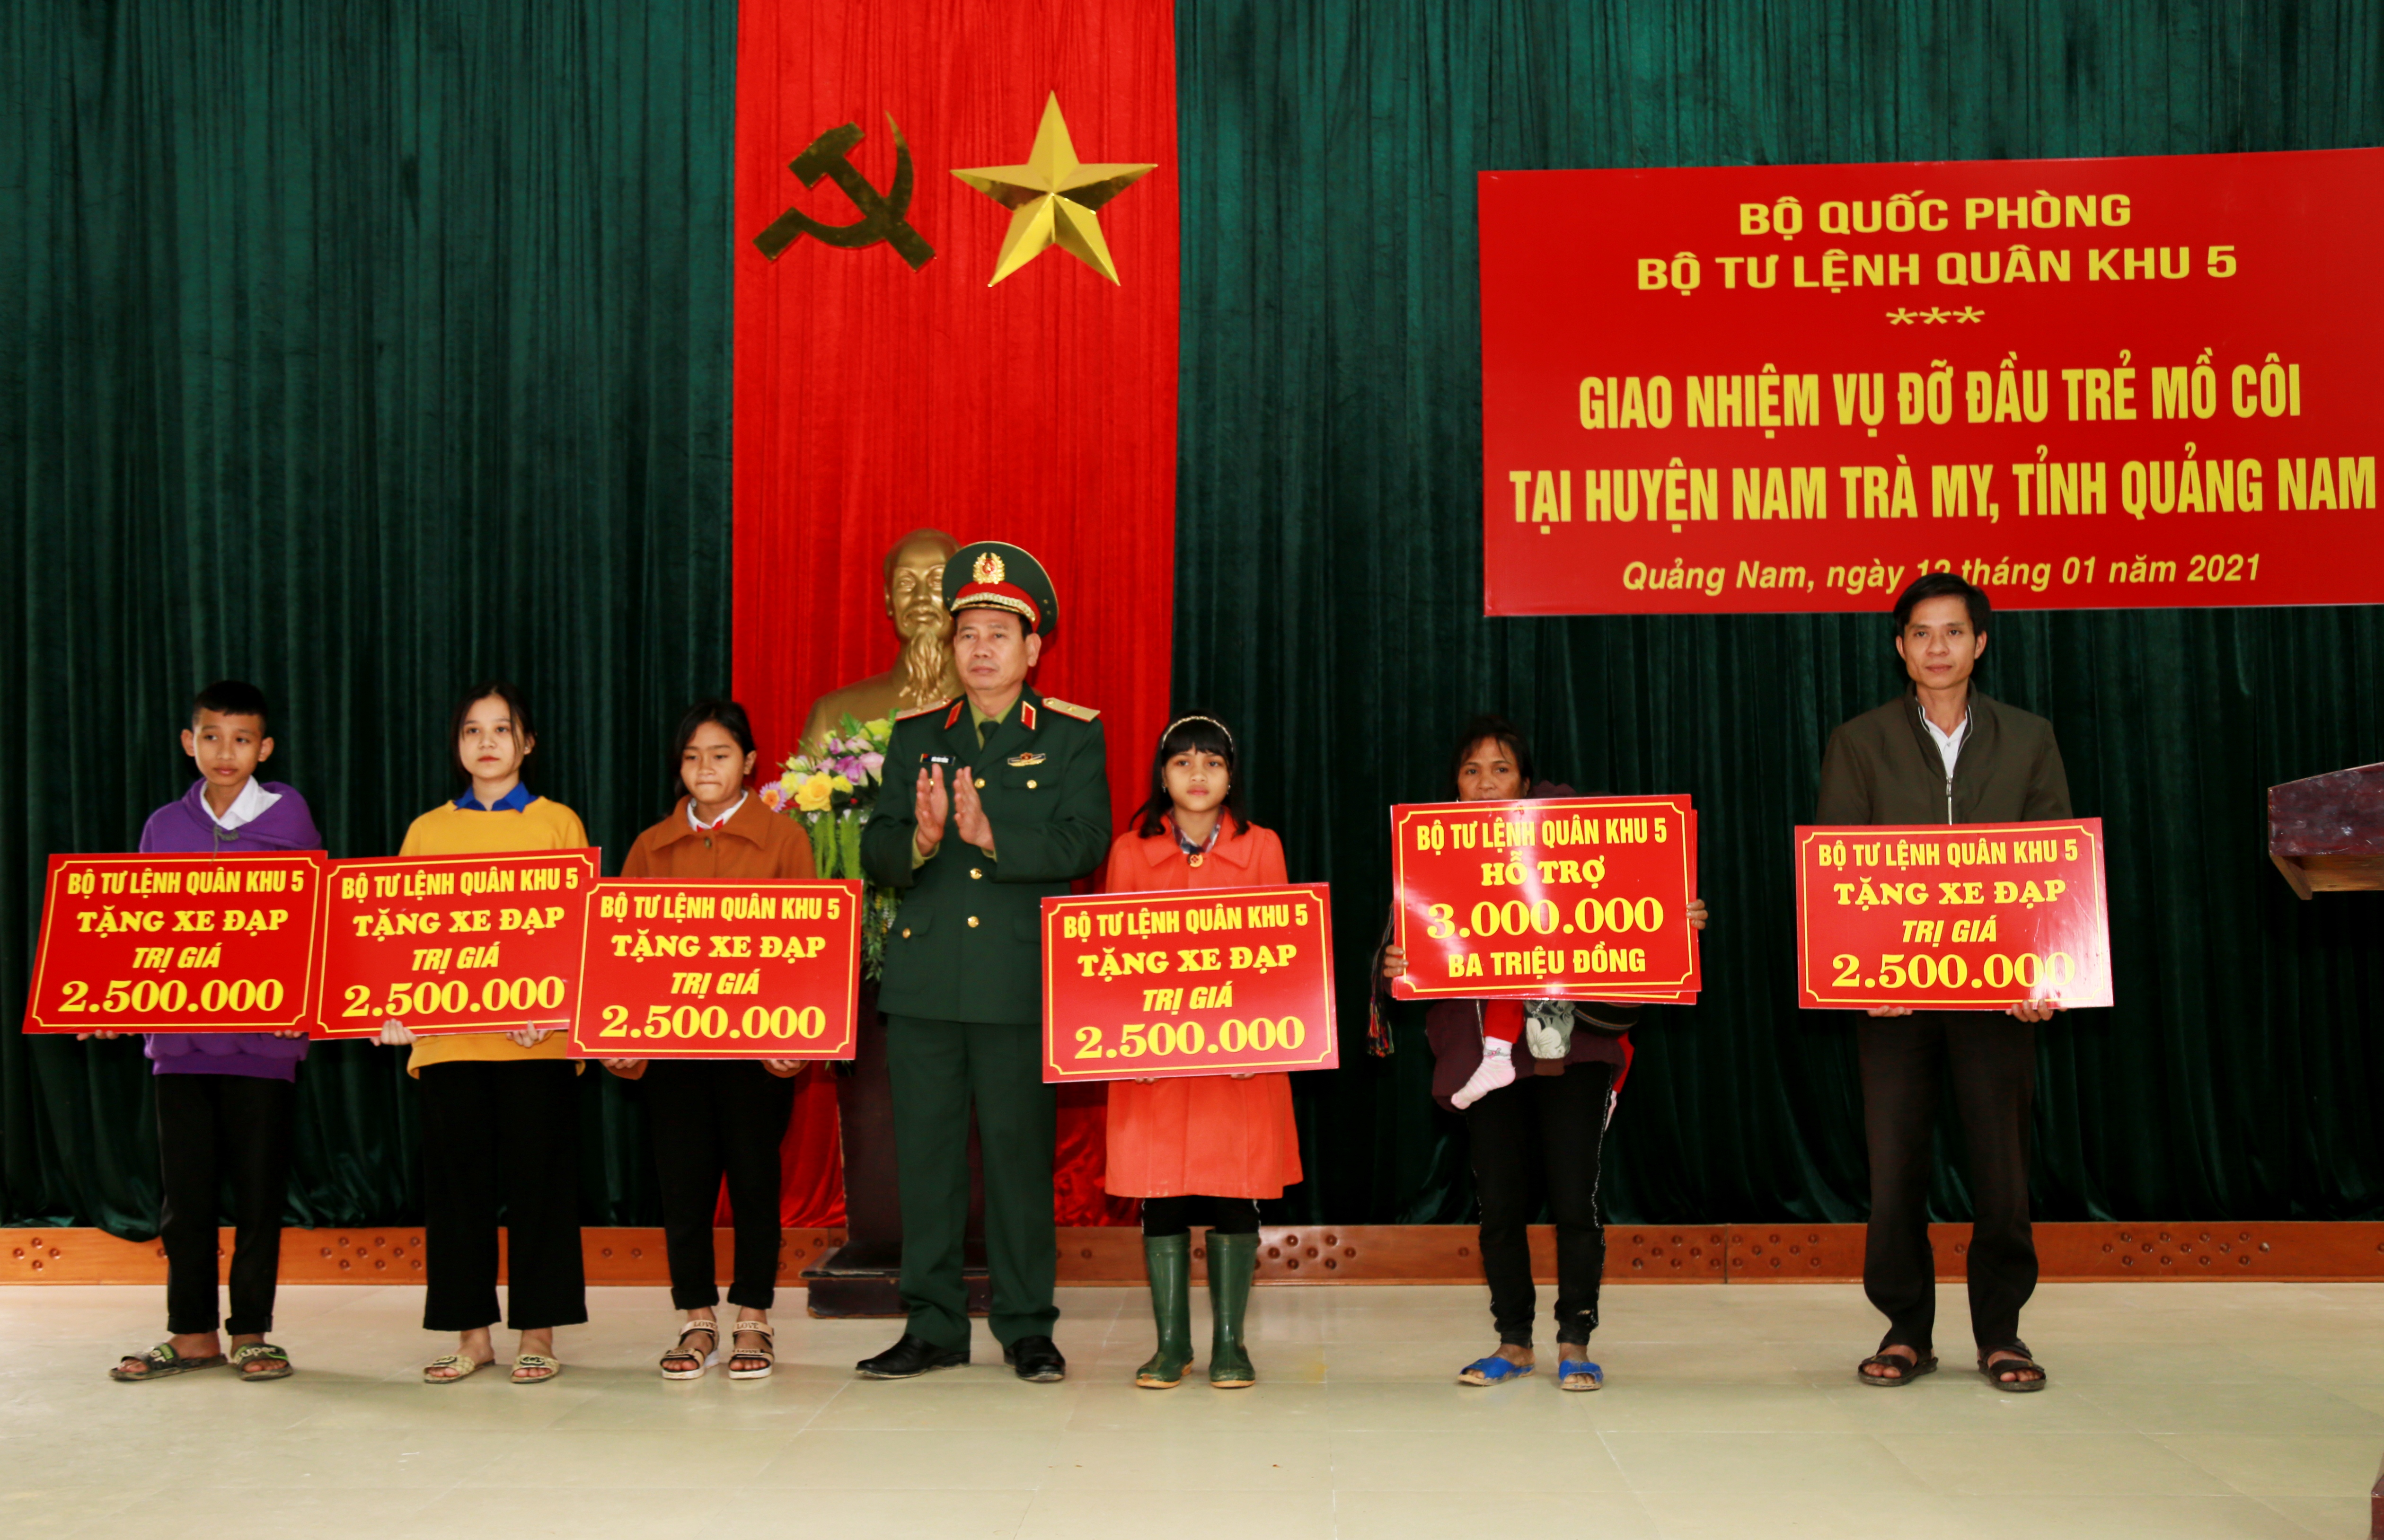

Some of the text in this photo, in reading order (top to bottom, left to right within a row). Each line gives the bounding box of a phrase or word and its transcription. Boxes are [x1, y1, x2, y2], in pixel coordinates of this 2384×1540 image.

[1740, 190, 2130, 240] BỘ QUỐC PHÒNG
[1638, 244, 2236, 296] BỘ TƯ LỆNH QUÂN KHU 5
[1580, 347, 2300, 439] GIAO NHIỆM VỤ ĐỠ ĐẦU TRẺ MỒ CÔI
[1510, 441, 2375, 535] TẠI HUYỆN NAM TRÀ MY, TỈNH QUẢNG NAM
[1623, 558, 1725, 597] Quảng
[1736, 561, 1814, 593] Nam,
[1827, 558, 1905, 595] ngày
[1961, 556, 2050, 592] tháng
[2063, 556, 2095, 584] 01
[2110, 554, 2176, 583] năm
[2188, 554, 2259, 582] 2021
[1417, 814, 1667, 855] BỘ TƯ LỆNH QUÂN KHU 5
[1481, 851, 1605, 889] HỖ TRỢ
[1819, 837, 2078, 871] BỘ TƯ LỆNH QUÂN KHU 5
[68, 867, 304, 898] BỘ TƯ LỆNH QUÂN KHU 5
[342, 866, 578, 903] BỘ TƯ LỆNH QUÂN KHU 5
[1834, 877, 2066, 911] TẶNG XE ĐẠP
[77, 906, 288, 938] TẶNG XE ĐẠP
[353, 906, 565, 942] TẶNG XE ĐẠP
[600, 891, 840, 923] BỘ TƯ LỆNH QUÂN KHU 5
[1064, 903, 1308, 942] BỘ TƯ LỆNH QUÂN KHU 5
[1427, 897, 1663, 939] 3.000.000
[611, 929, 826, 964] TẶNG XE ĐẠP
[1903, 915, 1996, 947] TRỊ GIÁ
[133, 942, 222, 973] TRỊ GIÁ
[412, 941, 500, 974] TRỊ GIÁ
[1077, 944, 1297, 982] TẶNG XE ĐẠP
[1448, 941, 1645, 979] BA TRIỆU ĐỒNG
[1832, 952, 2075, 988] 2.500.000
[58, 979, 283, 1012] 2.500.000
[342, 976, 565, 1017] 2.500.000
[671, 968, 760, 999] TRỊ GIÁ
[1143, 981, 1232, 1015] TRỊ GIÁ
[599, 1005, 826, 1038] 2.500.000
[1074, 1016, 1306, 1059] 2.500.000
